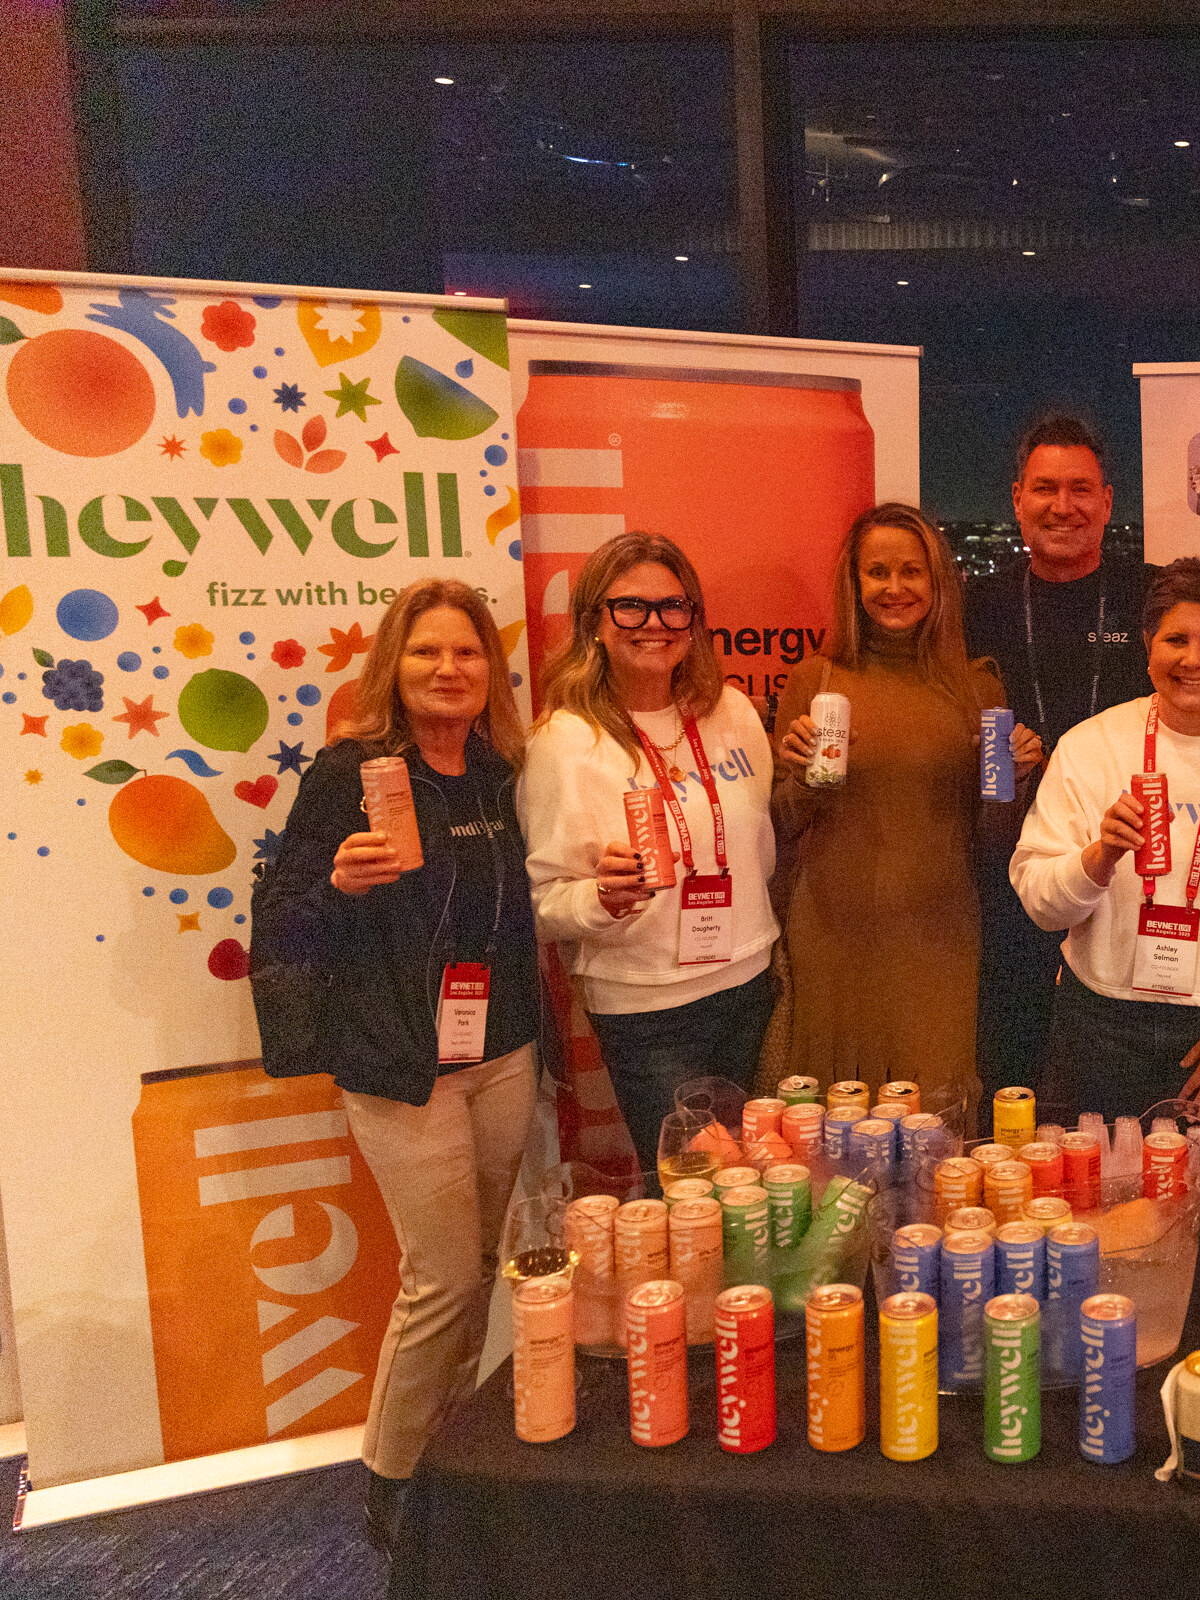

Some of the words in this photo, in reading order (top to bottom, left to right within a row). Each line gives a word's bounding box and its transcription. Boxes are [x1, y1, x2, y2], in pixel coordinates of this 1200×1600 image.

[0, 464, 463, 577] heywell
[206, 581, 267, 607] fizz
[275, 581, 348, 606] with
[711, 627, 826, 664] nergy
[1087, 632, 1128, 643] seaz
[817, 727, 846, 739] steaz
[981, 716, 1000, 796] heywell
[676, 815, 691, 852] BEVNET
[712, 803, 724, 840] BEVNET
[1143, 782, 1167, 870] heywell
[688, 892, 715, 901] BEVNET
[1146, 920, 1178, 931] BEVNET
[1156, 928, 1177, 936] Angeles
[1153, 953, 1179, 962] Selman
[1155, 944, 1178, 954] Ashley
[715, 1316, 747, 1447] heywell
[888, 1324, 924, 1455] heywell
[992, 1328, 1028, 1457] heywell
[1080, 1324, 1111, 1457] heywell
